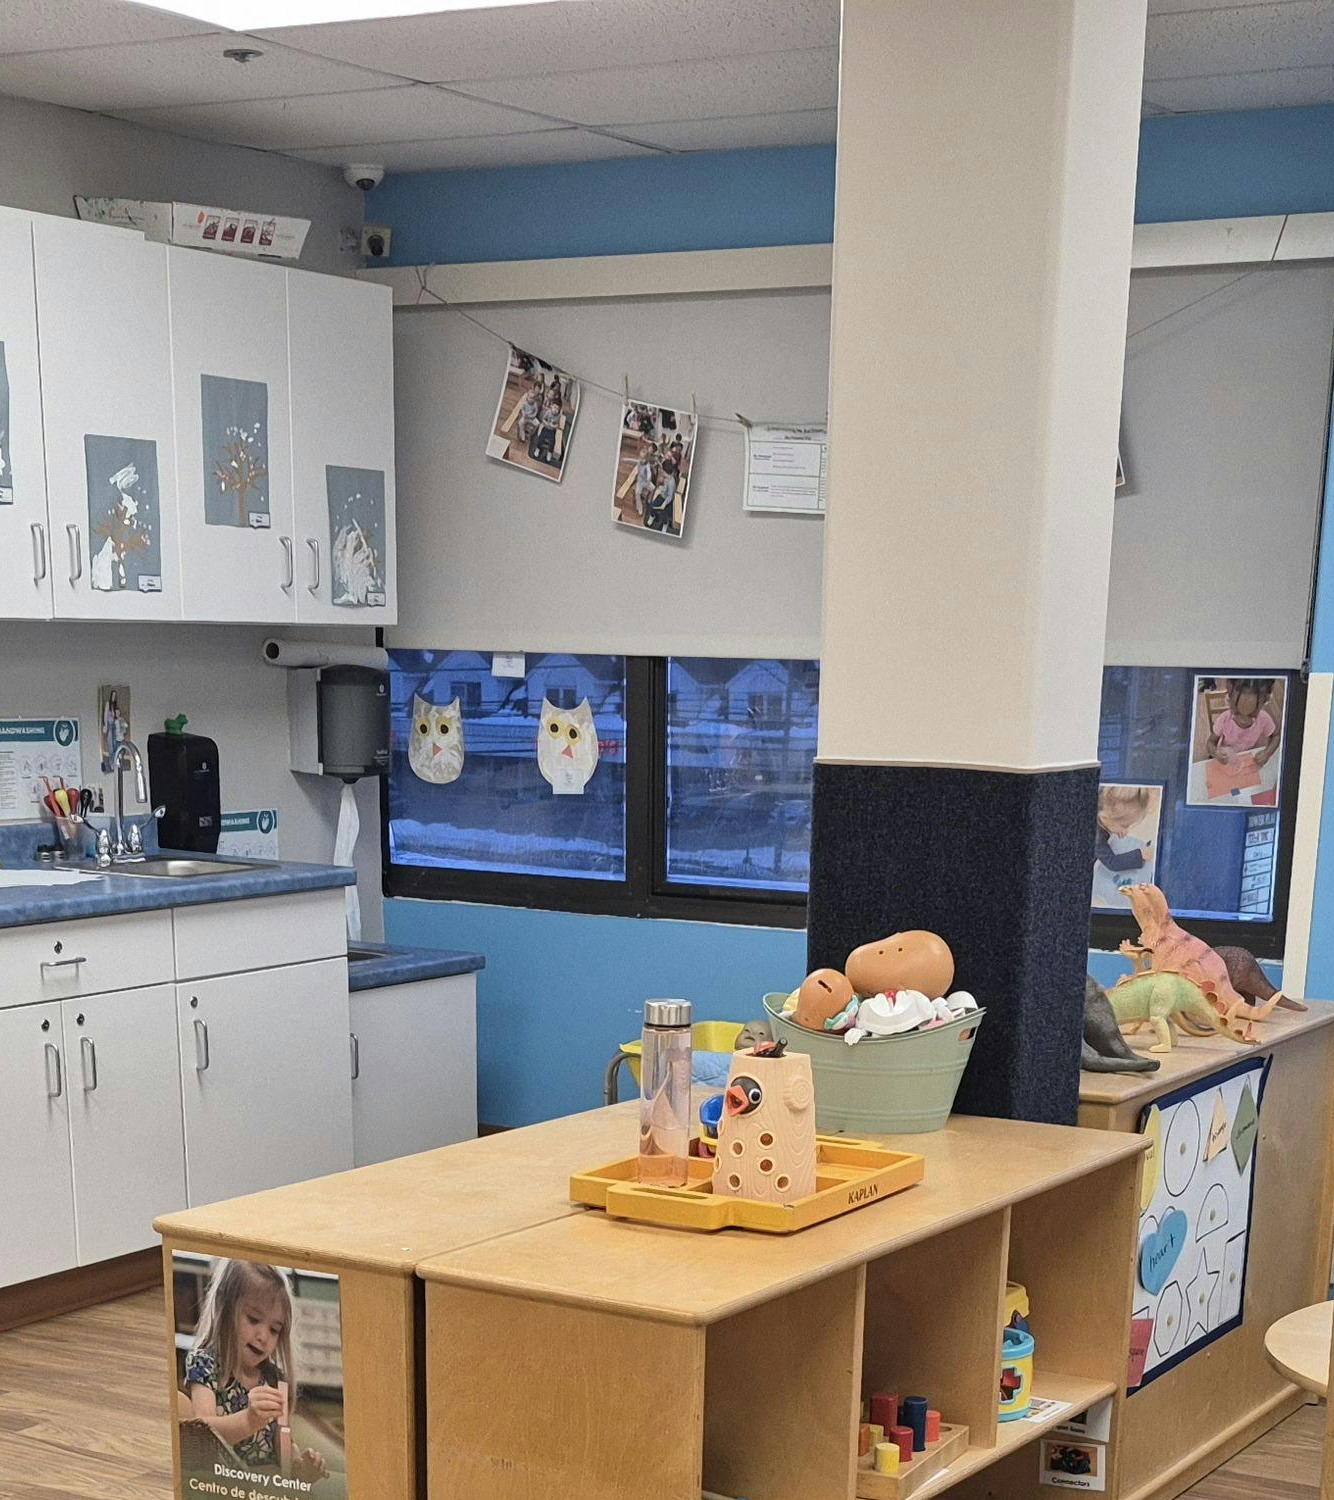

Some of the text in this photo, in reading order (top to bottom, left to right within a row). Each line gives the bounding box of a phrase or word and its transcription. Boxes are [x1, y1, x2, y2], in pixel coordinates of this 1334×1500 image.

[848, 1184, 878, 1204] KAPLAN
[1148, 1232, 1176, 1270] heart
[189, 1478, 228, 1496] Centro
[231, 1486, 245, 1499] de
[214, 1463, 312, 1492] Discovery Center
